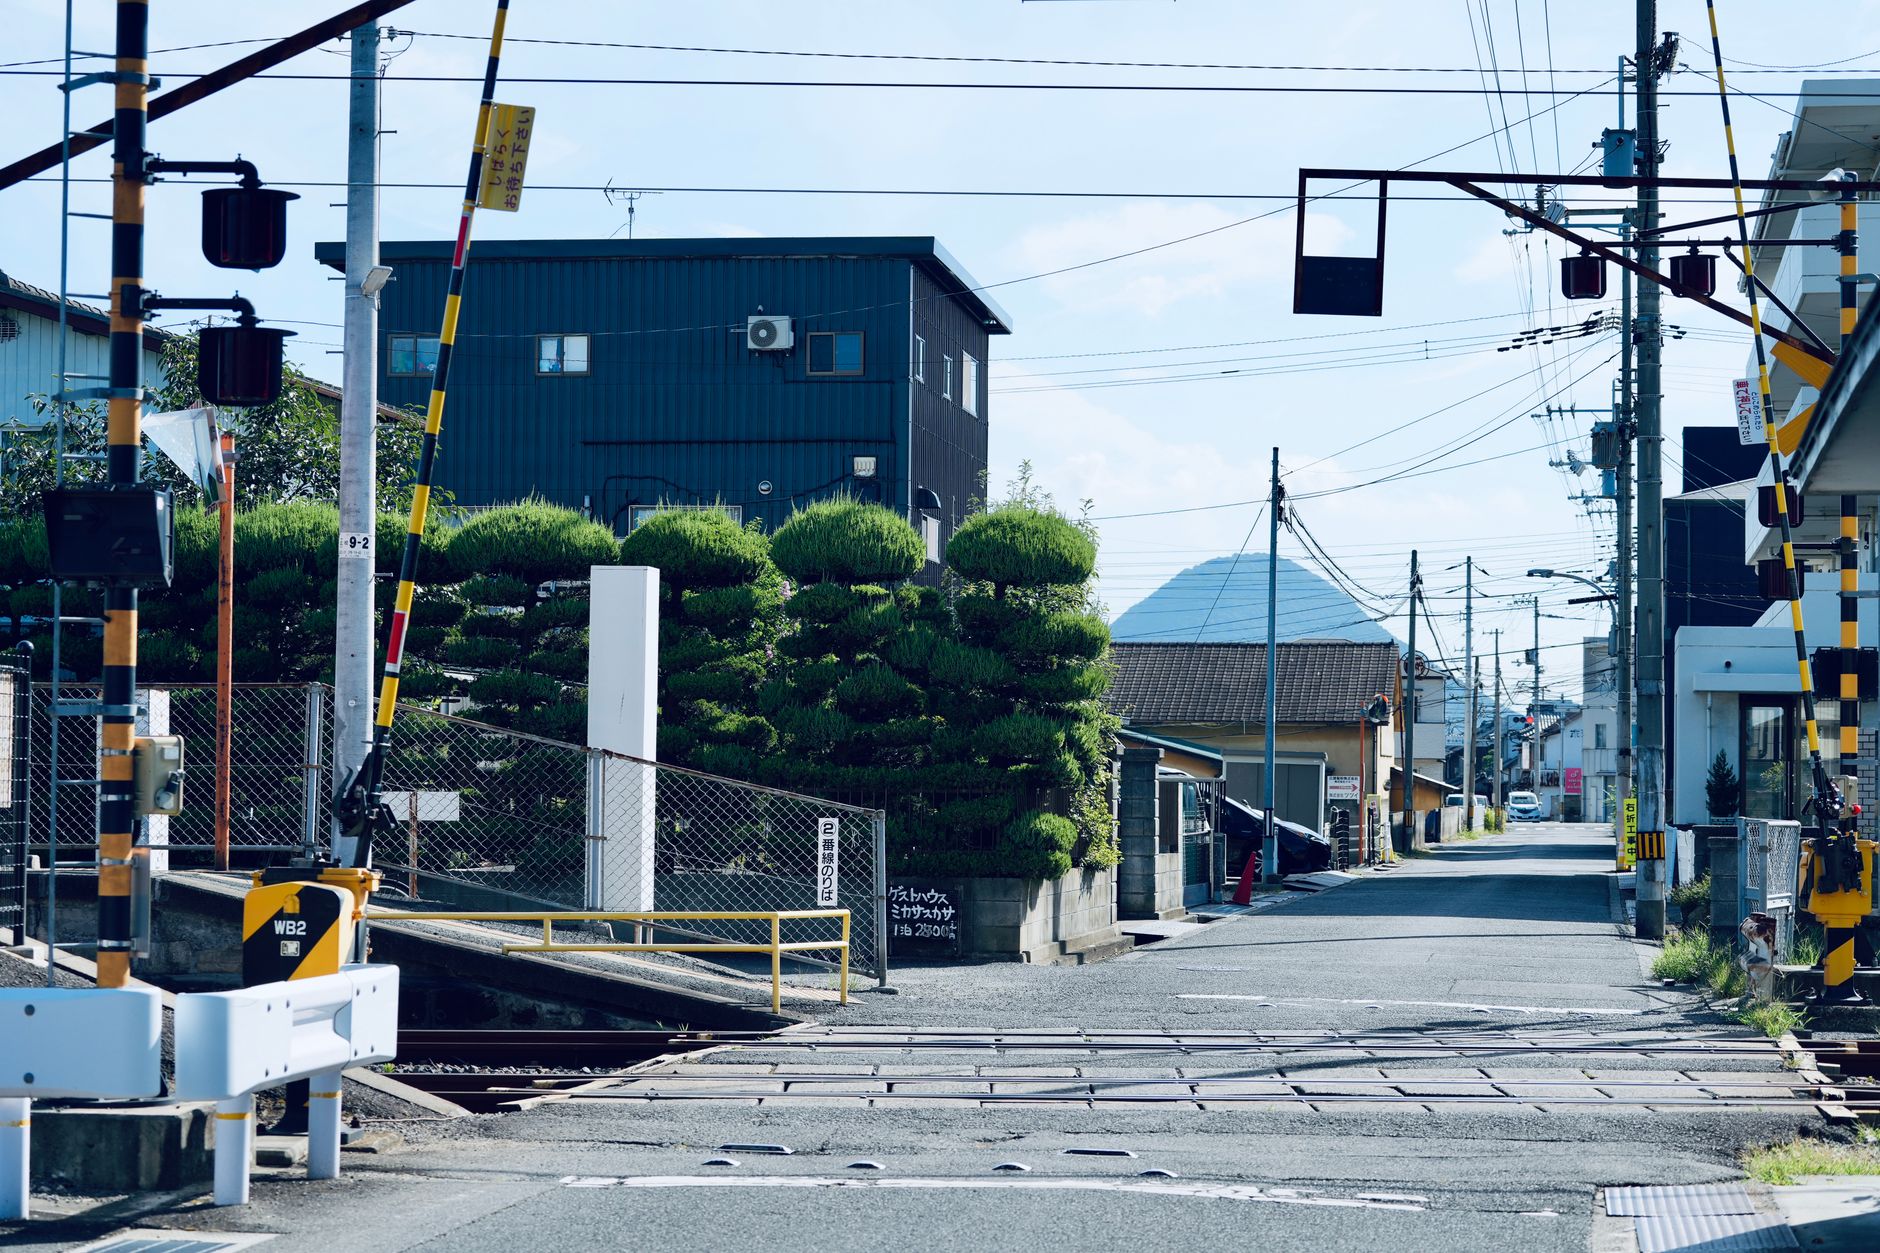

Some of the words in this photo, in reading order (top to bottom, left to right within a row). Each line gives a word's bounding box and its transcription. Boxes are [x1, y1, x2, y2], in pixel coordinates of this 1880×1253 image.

[489, 129, 510, 186] しばらく
[504, 109, 530, 208] お待ち下さい
[349, 536, 369, 549] 9-2
[888, 885, 949, 905] ゲストハウス
[891, 904, 956, 921] ミカサスカサ
[274, 920, 307, 936] WB2
